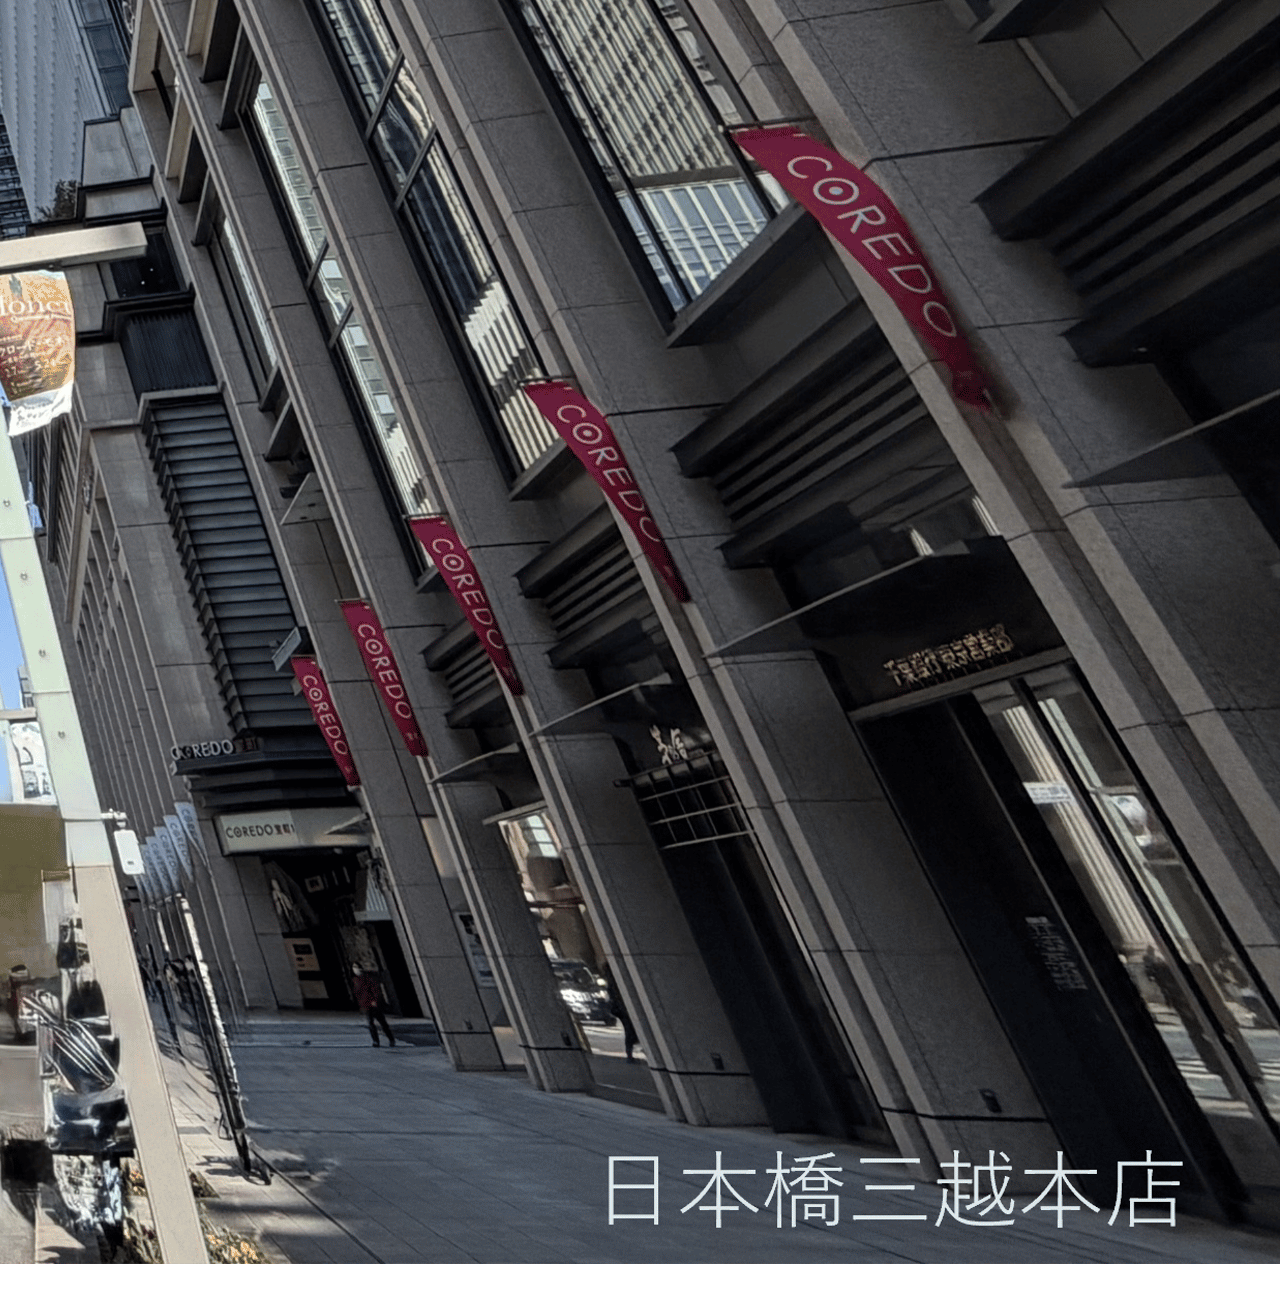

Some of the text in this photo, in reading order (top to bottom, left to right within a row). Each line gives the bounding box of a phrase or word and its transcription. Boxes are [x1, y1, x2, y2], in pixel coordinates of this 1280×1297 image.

[786, 155, 958, 339] COREDO
[556, 404, 664, 543] COREDO
[431, 538, 505, 650] COREDO
[303, 673, 347, 757] COREDO
[356, 623, 412, 719] COREDO
